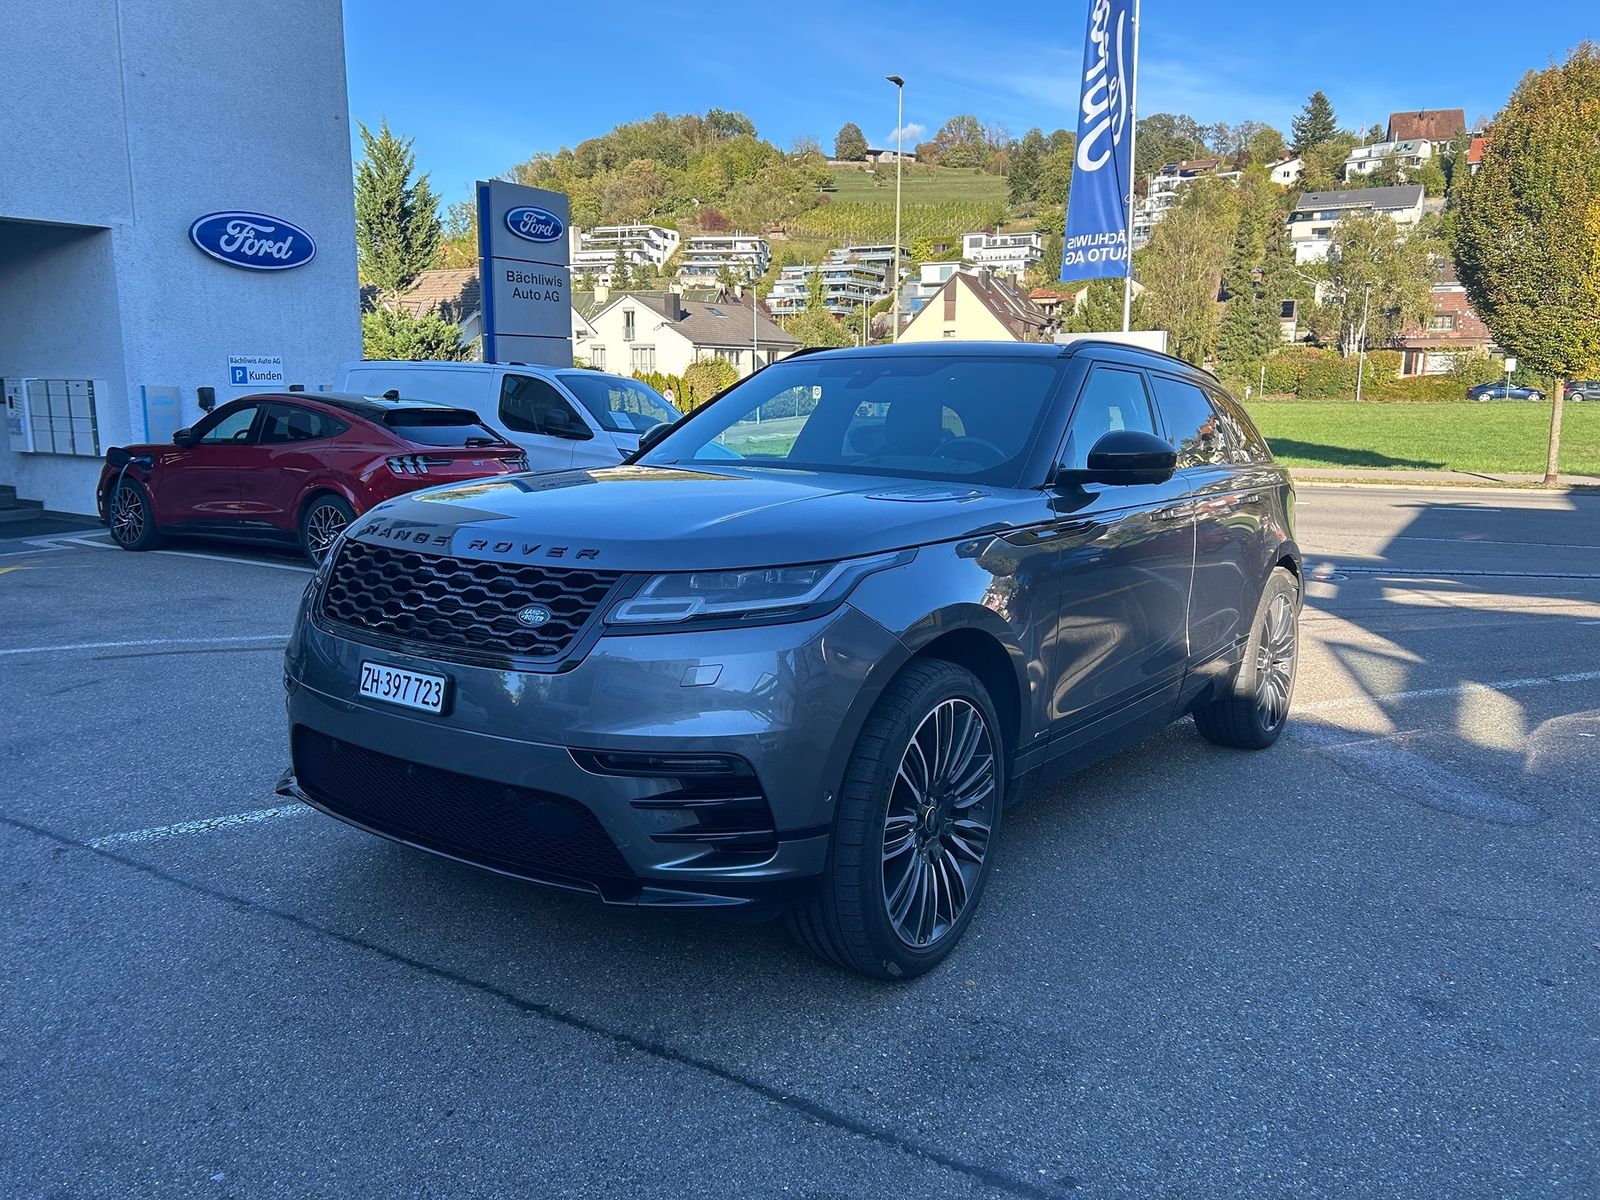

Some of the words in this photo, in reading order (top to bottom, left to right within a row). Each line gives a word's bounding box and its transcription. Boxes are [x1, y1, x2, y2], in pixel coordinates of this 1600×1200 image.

[519, 211, 554, 236] Ford
[219, 219, 293, 260] Ford
[506, 270, 563, 288] Bächliwis
[512, 287, 541, 301] Auto
[543, 290, 560, 303] AG
[257, 357, 272, 365] Auto
[272, 357, 281, 365] AG
[249, 370, 282, 381] Kunden
[365, 523, 451, 547] RANGE
[467, 539, 600, 560] ROVER
[523, 614, 545, 622] ROVER
